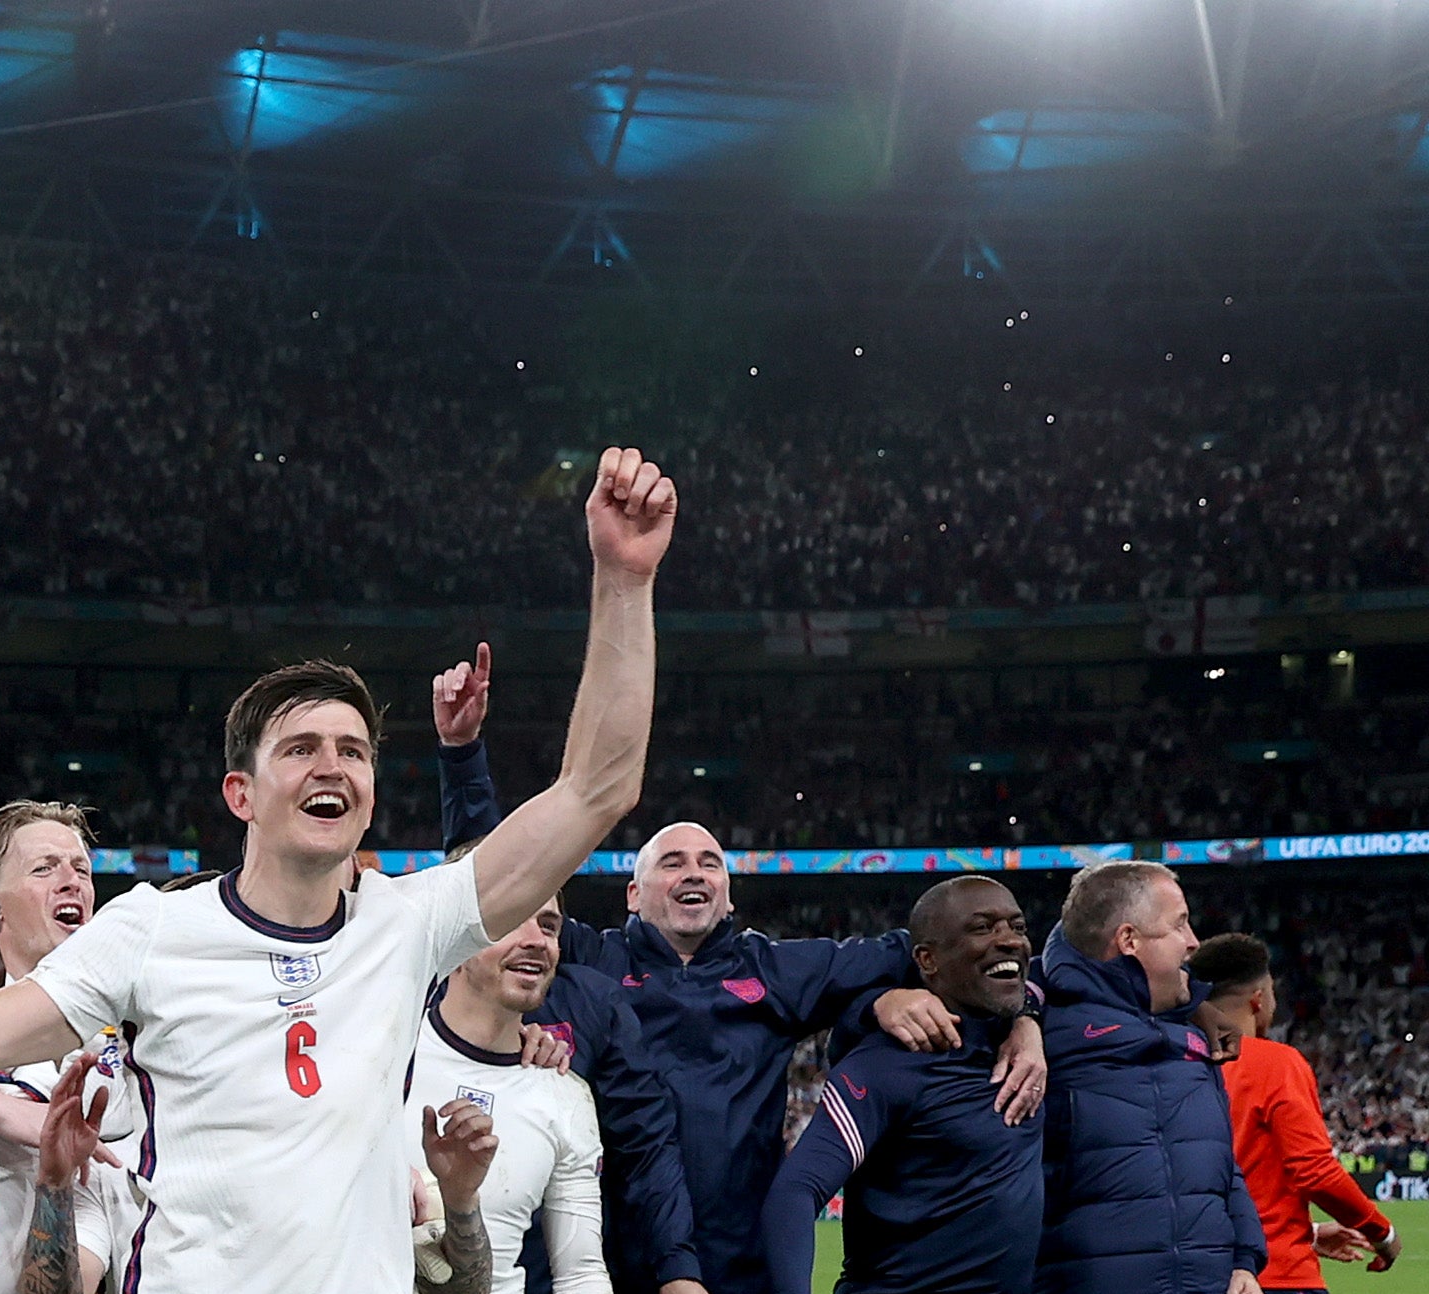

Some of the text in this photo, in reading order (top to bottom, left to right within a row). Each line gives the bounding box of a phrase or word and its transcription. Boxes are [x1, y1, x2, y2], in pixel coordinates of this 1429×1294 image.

[1278, 837, 1339, 858] UEFA
[1340, 834, 1403, 855] EURO
[285, 1021, 322, 1098] 6
